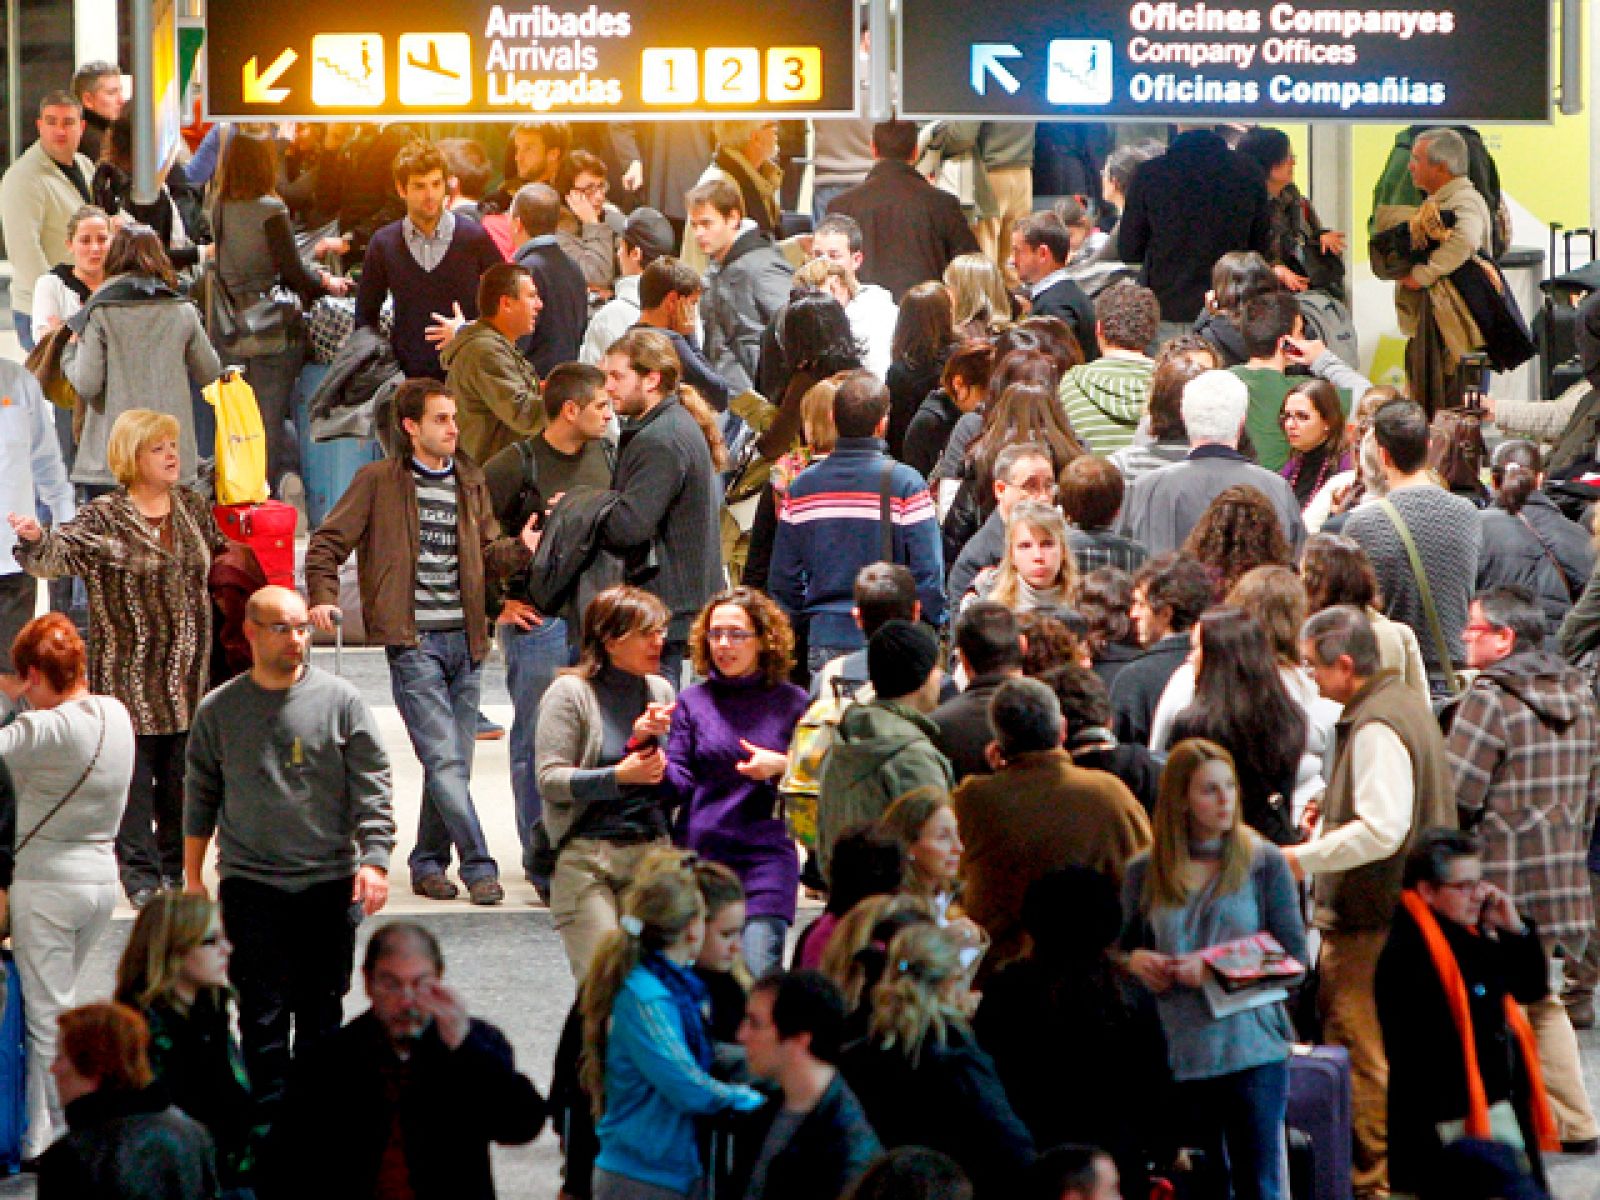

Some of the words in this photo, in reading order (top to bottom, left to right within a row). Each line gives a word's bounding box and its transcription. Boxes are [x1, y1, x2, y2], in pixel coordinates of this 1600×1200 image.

[486, 5, 631, 38] Arribades
[1130, 3, 1261, 32] Oficinas
[1270, 3, 1454, 39] Companyes
[487, 39, 598, 71] Arrivals
[1129, 37, 1256, 69] Company
[1263, 38, 1357, 64] Offices
[664, 60, 676, 92] 1
[722, 58, 742, 91] 2
[784, 57, 805, 91] 3
[1130, 74, 1259, 103] Oficinas
[487, 73, 622, 110] Llegadas
